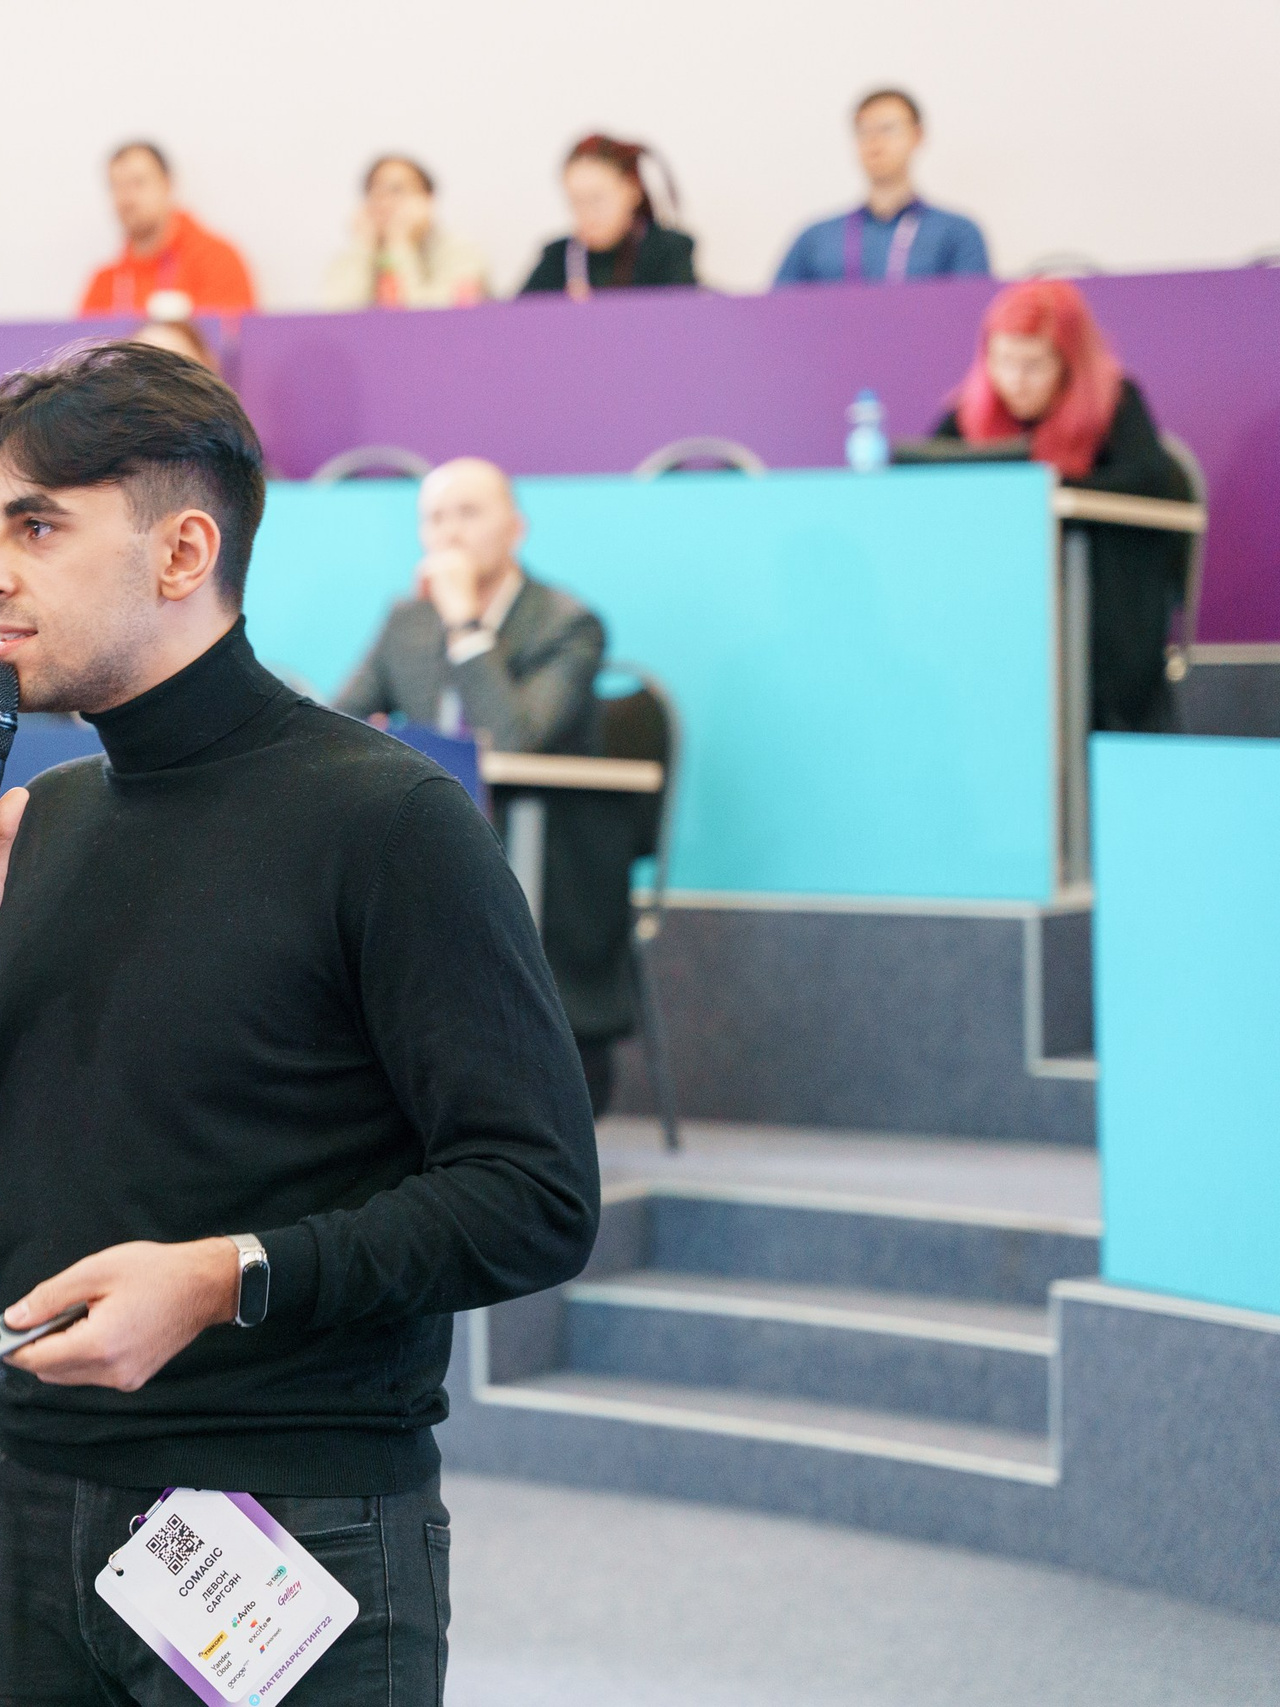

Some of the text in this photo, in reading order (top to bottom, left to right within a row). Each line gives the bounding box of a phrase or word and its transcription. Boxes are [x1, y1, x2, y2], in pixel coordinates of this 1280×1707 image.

[178, 1547, 223, 1597] COMAGIC
[271, 1568, 285, 1582] tech
[202, 1570, 229, 1602] ЛЕВОН
[206, 1573, 242, 1613] САРГСЯН
[277, 1580, 302, 1606] Gallery
[237, 1601, 256, 1621] Avito
[248, 1622, 268, 1644] excite
[204, 1634, 224, 1655] TINKOFF
[259, 1615, 333, 1696] МАТЕМАРКЕТИНГ22
[211, 1651, 231, 1671] Yandex
[216, 1660, 233, 1677] Cloud
